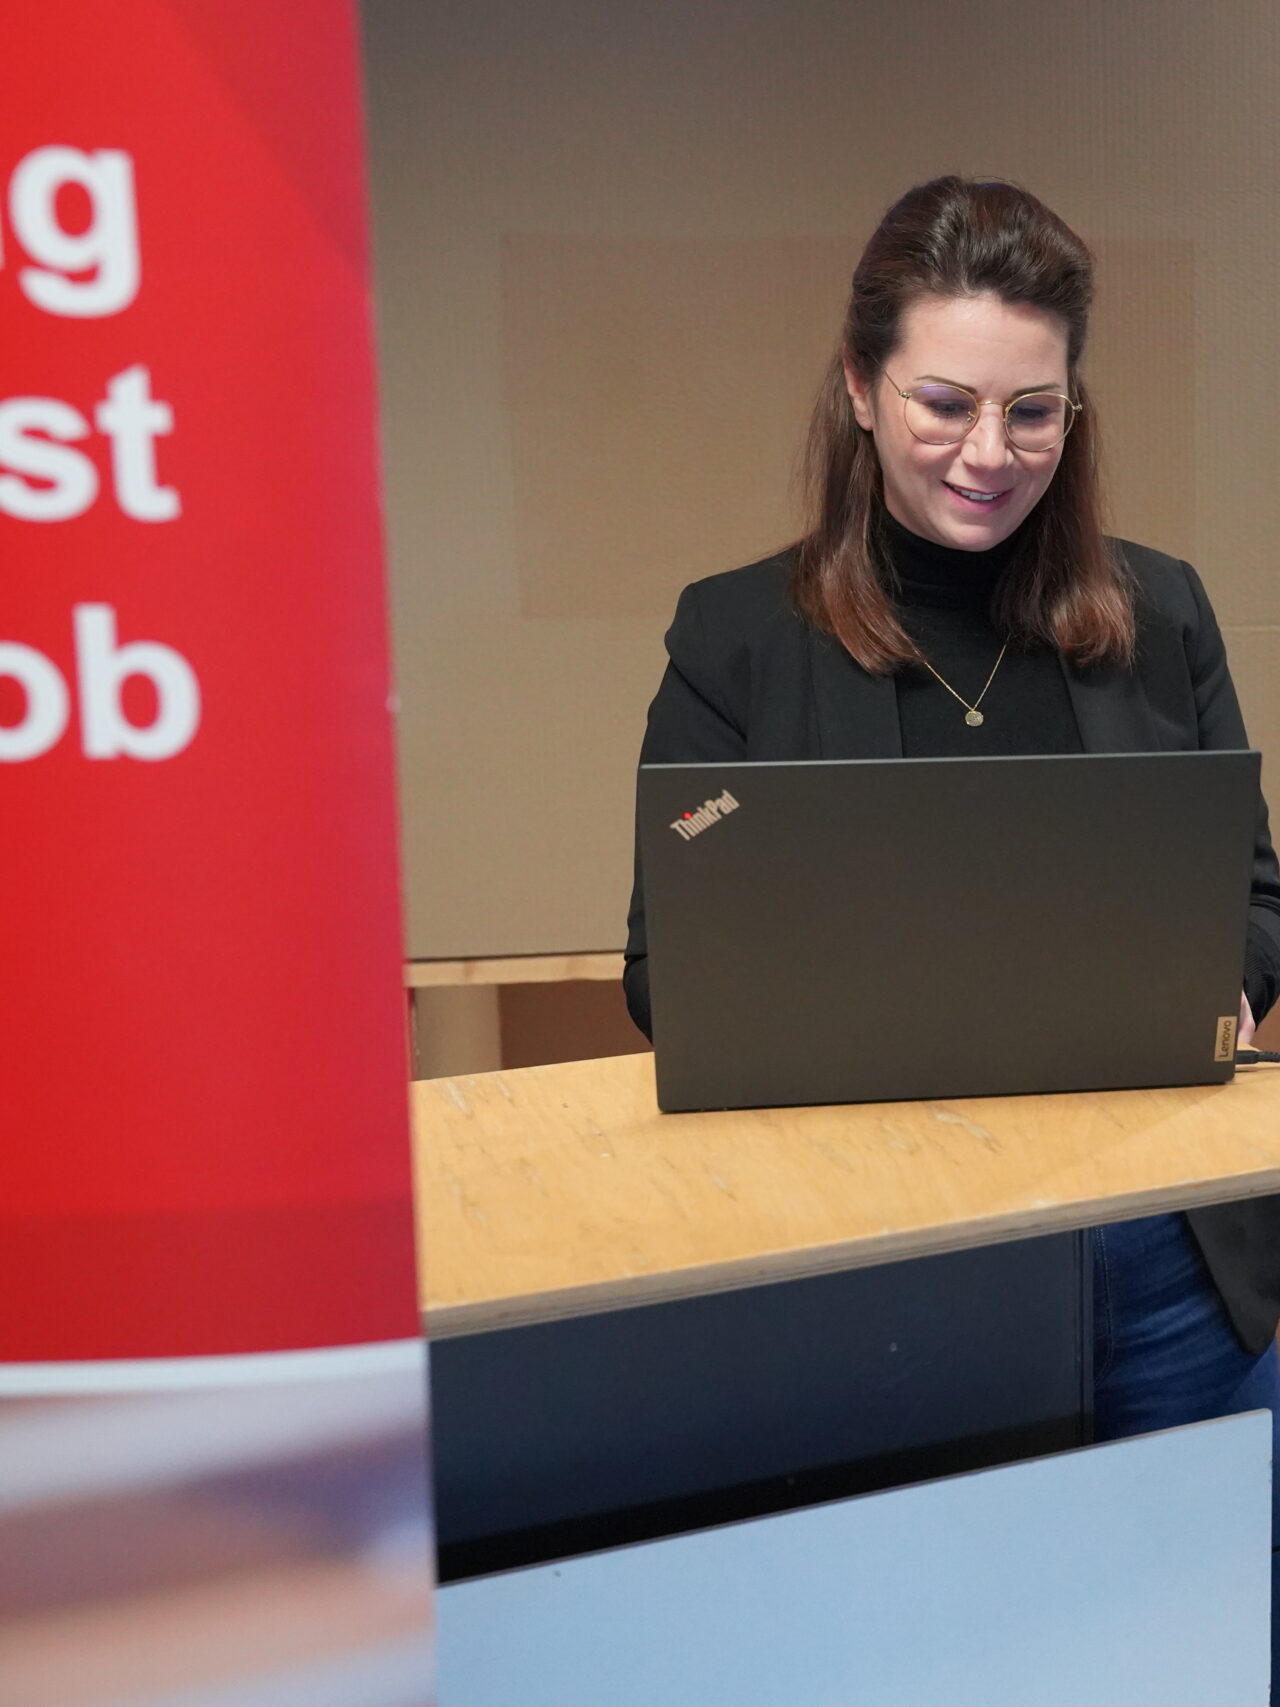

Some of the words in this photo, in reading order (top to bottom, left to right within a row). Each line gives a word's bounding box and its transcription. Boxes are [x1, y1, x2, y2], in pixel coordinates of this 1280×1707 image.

[0, 145, 142, 319] g
[669, 788, 740, 840] ThinkPad
[1218, 1020, 1232, 1058] Lenovo
